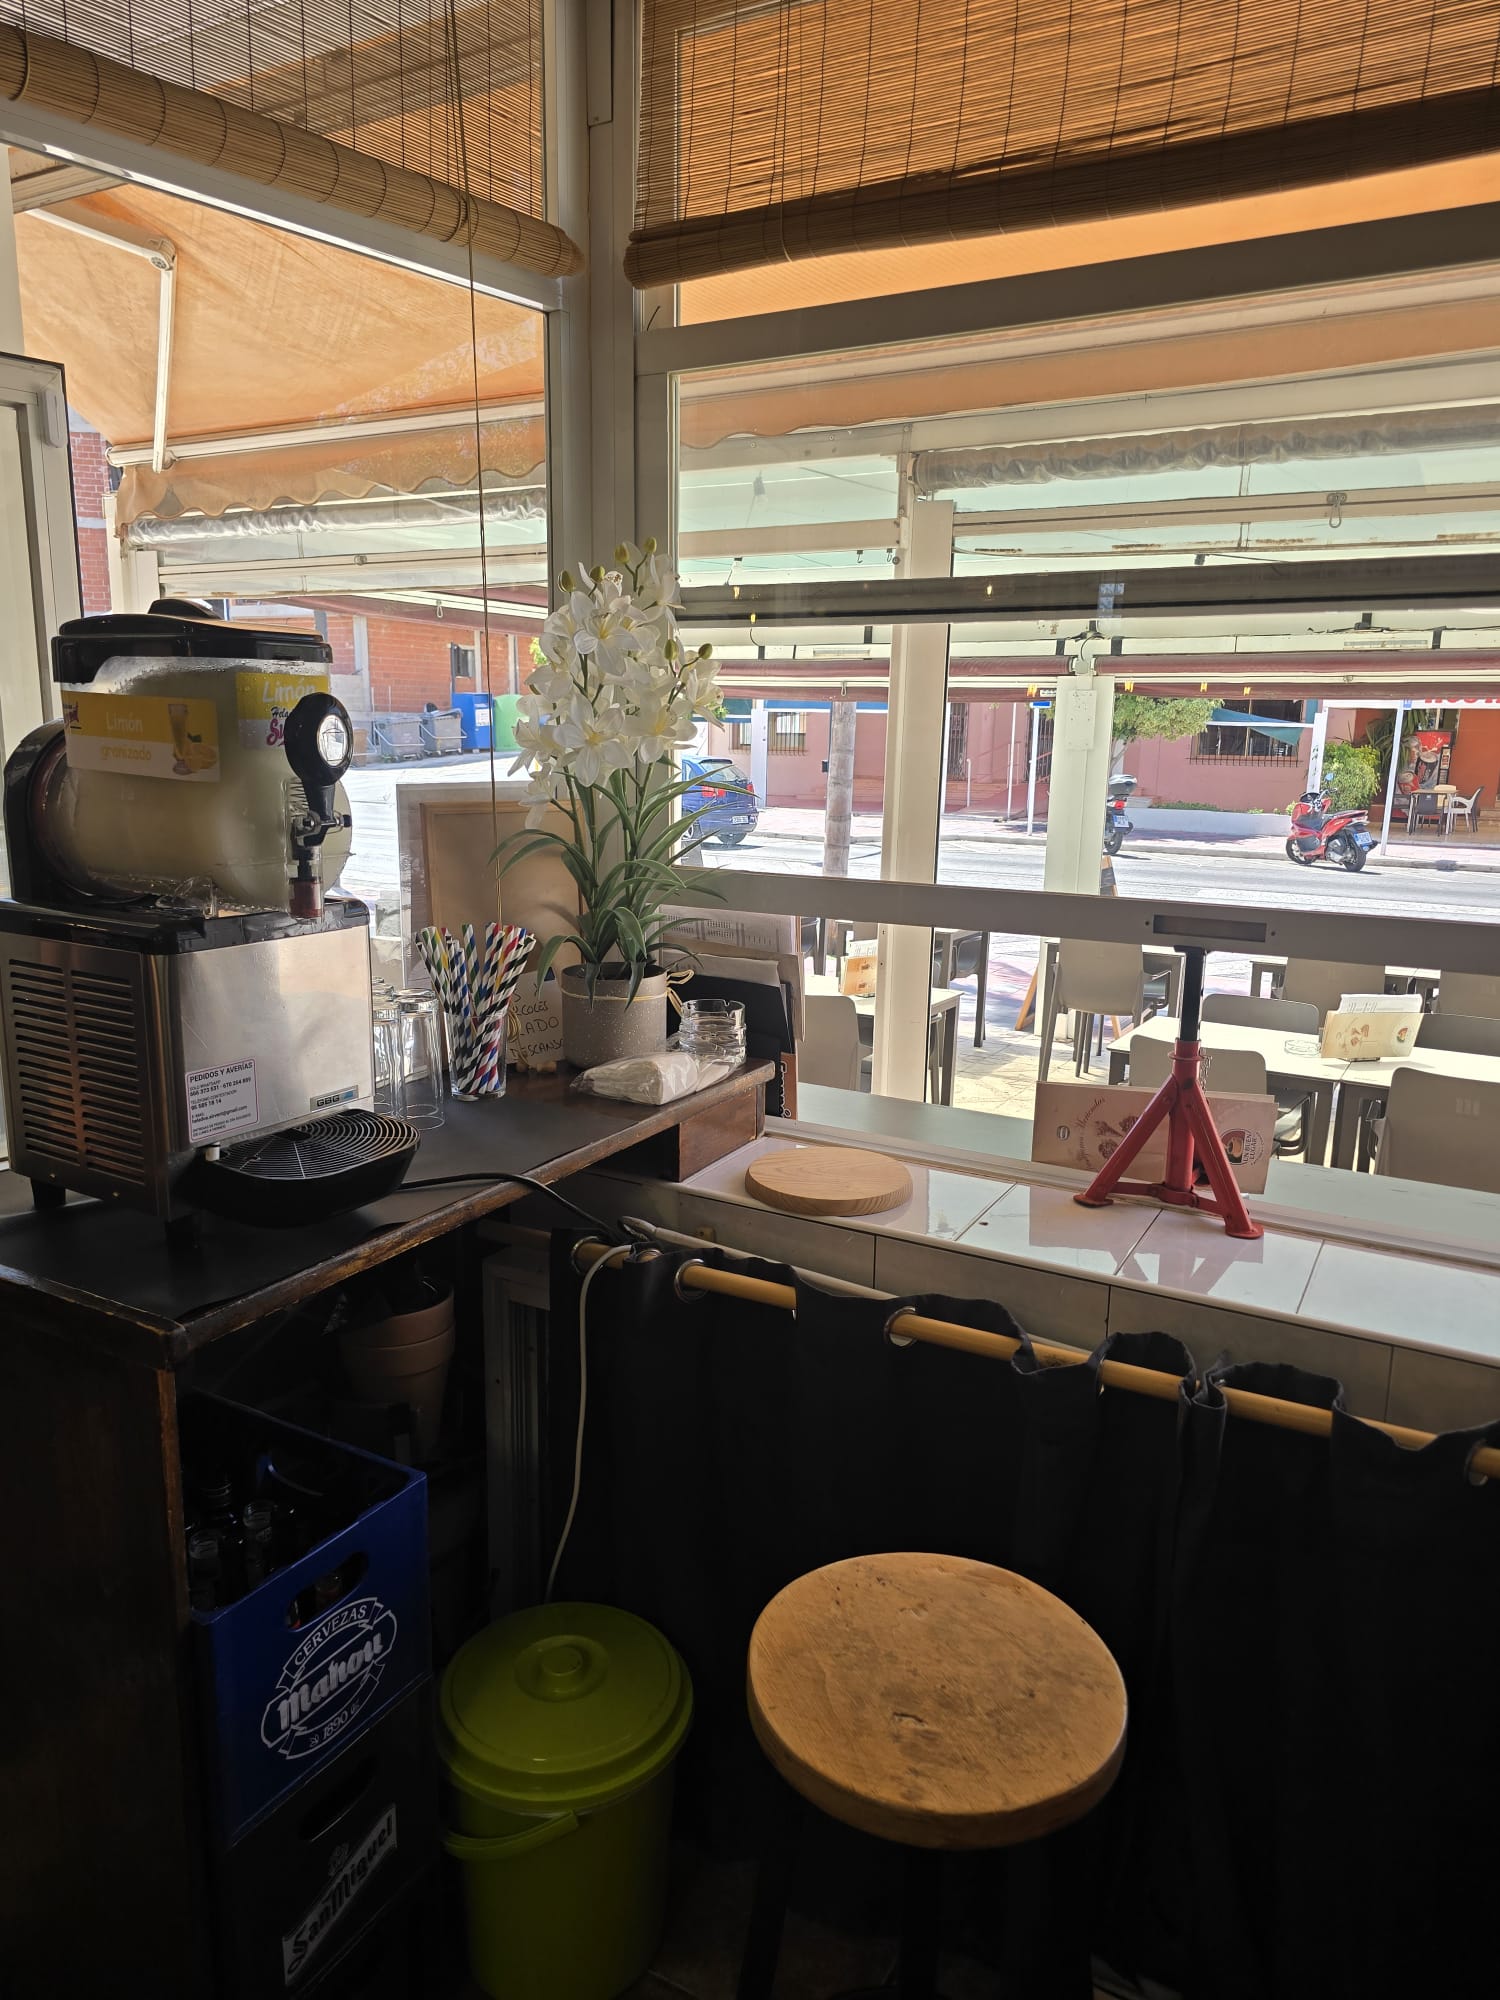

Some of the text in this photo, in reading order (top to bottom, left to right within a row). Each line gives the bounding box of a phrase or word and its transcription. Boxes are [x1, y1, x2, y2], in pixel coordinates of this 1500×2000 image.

[105, 711, 143, 733] Limón
[101, 745, 152, 761] granizado
[189, 1070, 219, 1083] PEDIDOS
[220, 1068, 225, 1076] Y
[316, 1094, 340, 1107] GBG
[1244, 1133, 1252, 1152] BUEN
[1249, 1138, 1257, 1160] LUGAR
[294, 1604, 368, 1666] CERVEZAS
[276, 1632, 384, 1732] Mahou
[323, 1710, 349, 1740] 1890
